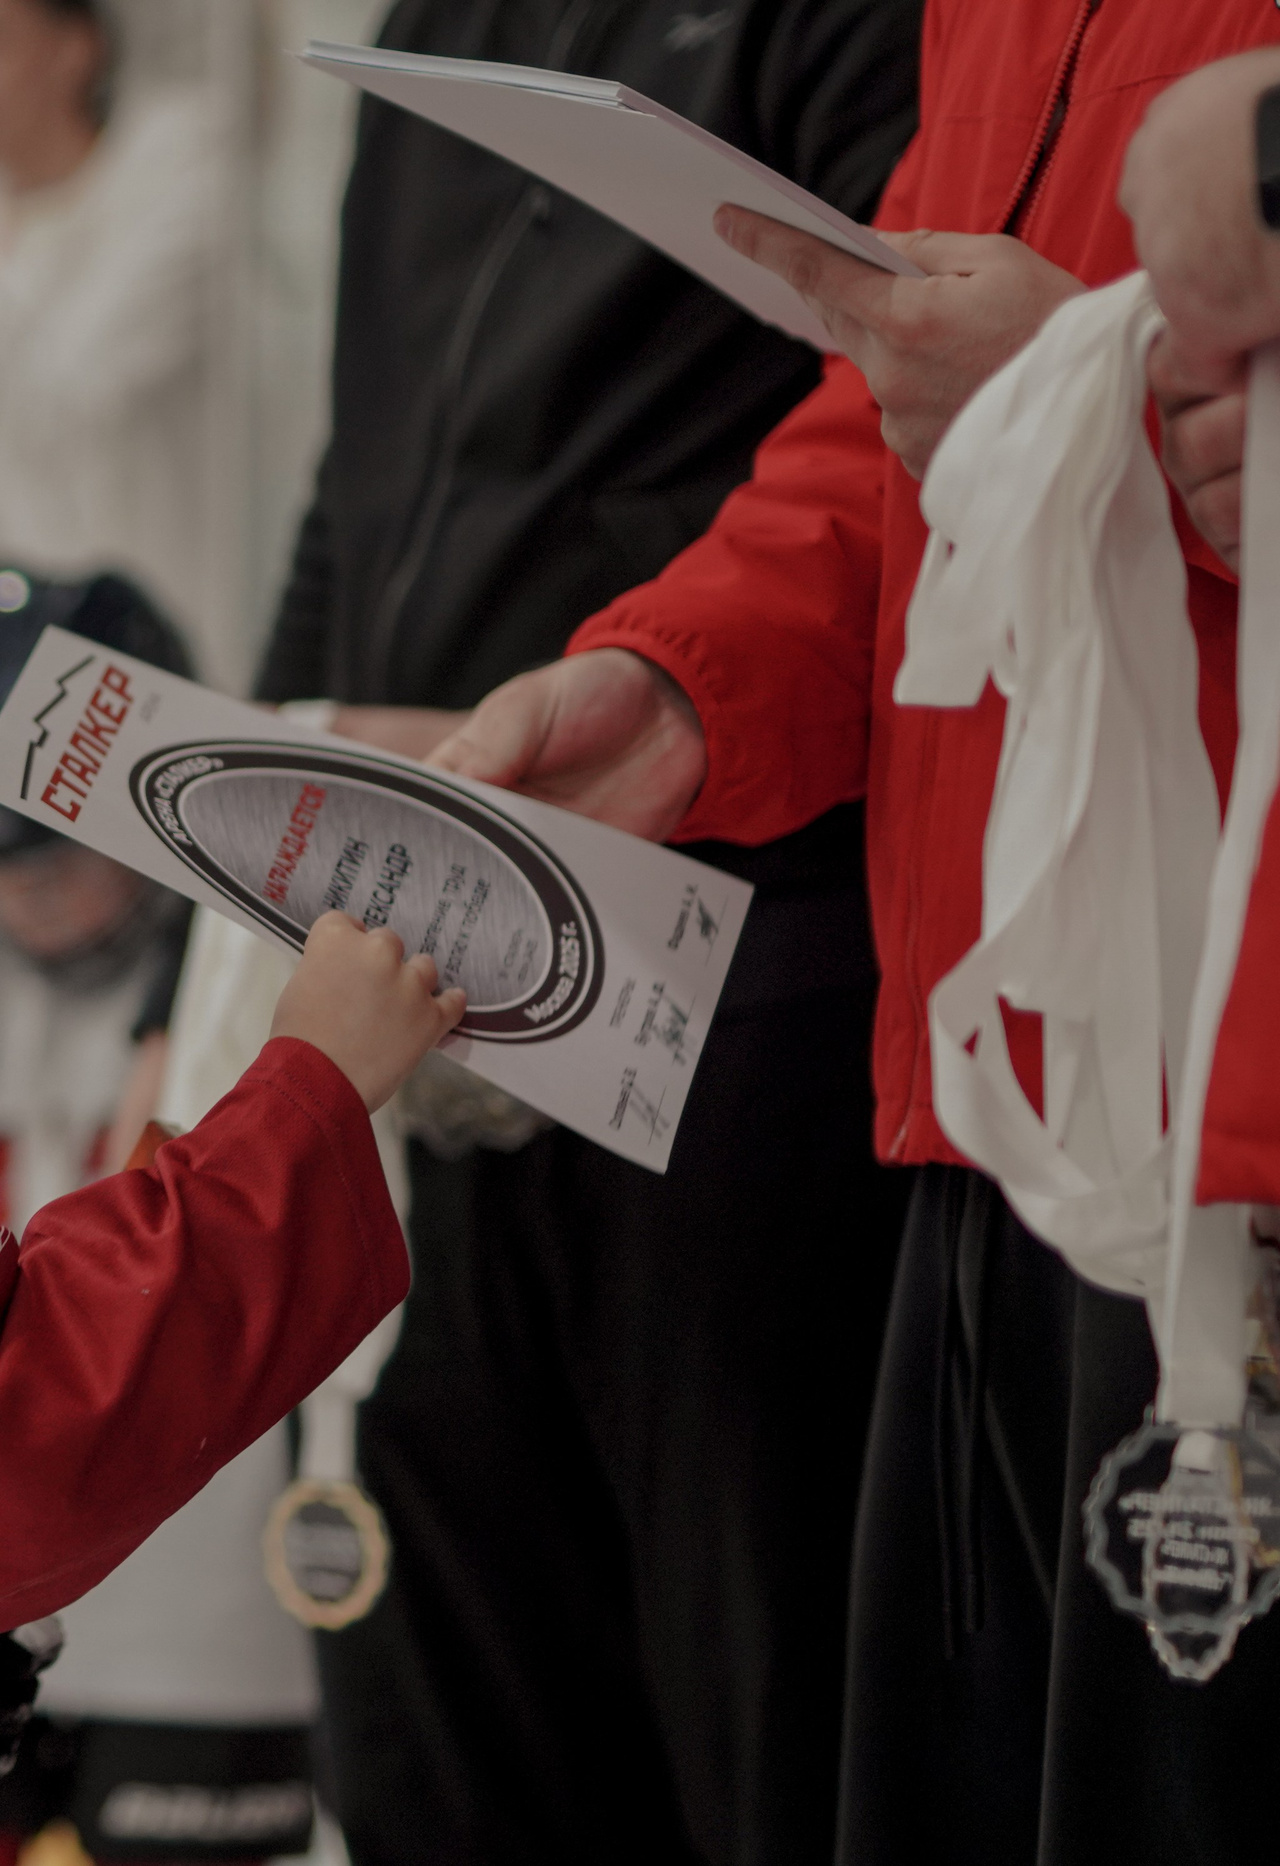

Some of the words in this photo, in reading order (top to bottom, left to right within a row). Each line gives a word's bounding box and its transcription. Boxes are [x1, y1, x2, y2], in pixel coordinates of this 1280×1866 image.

[41, 663, 134, 823] СТАЛКЕР
[262, 782, 328, 906] НАГРАЖДАЕТСЯ
[322, 836, 370, 911] НИКИТИН
[362, 842, 414, 930] ЛЕКСАНДР
